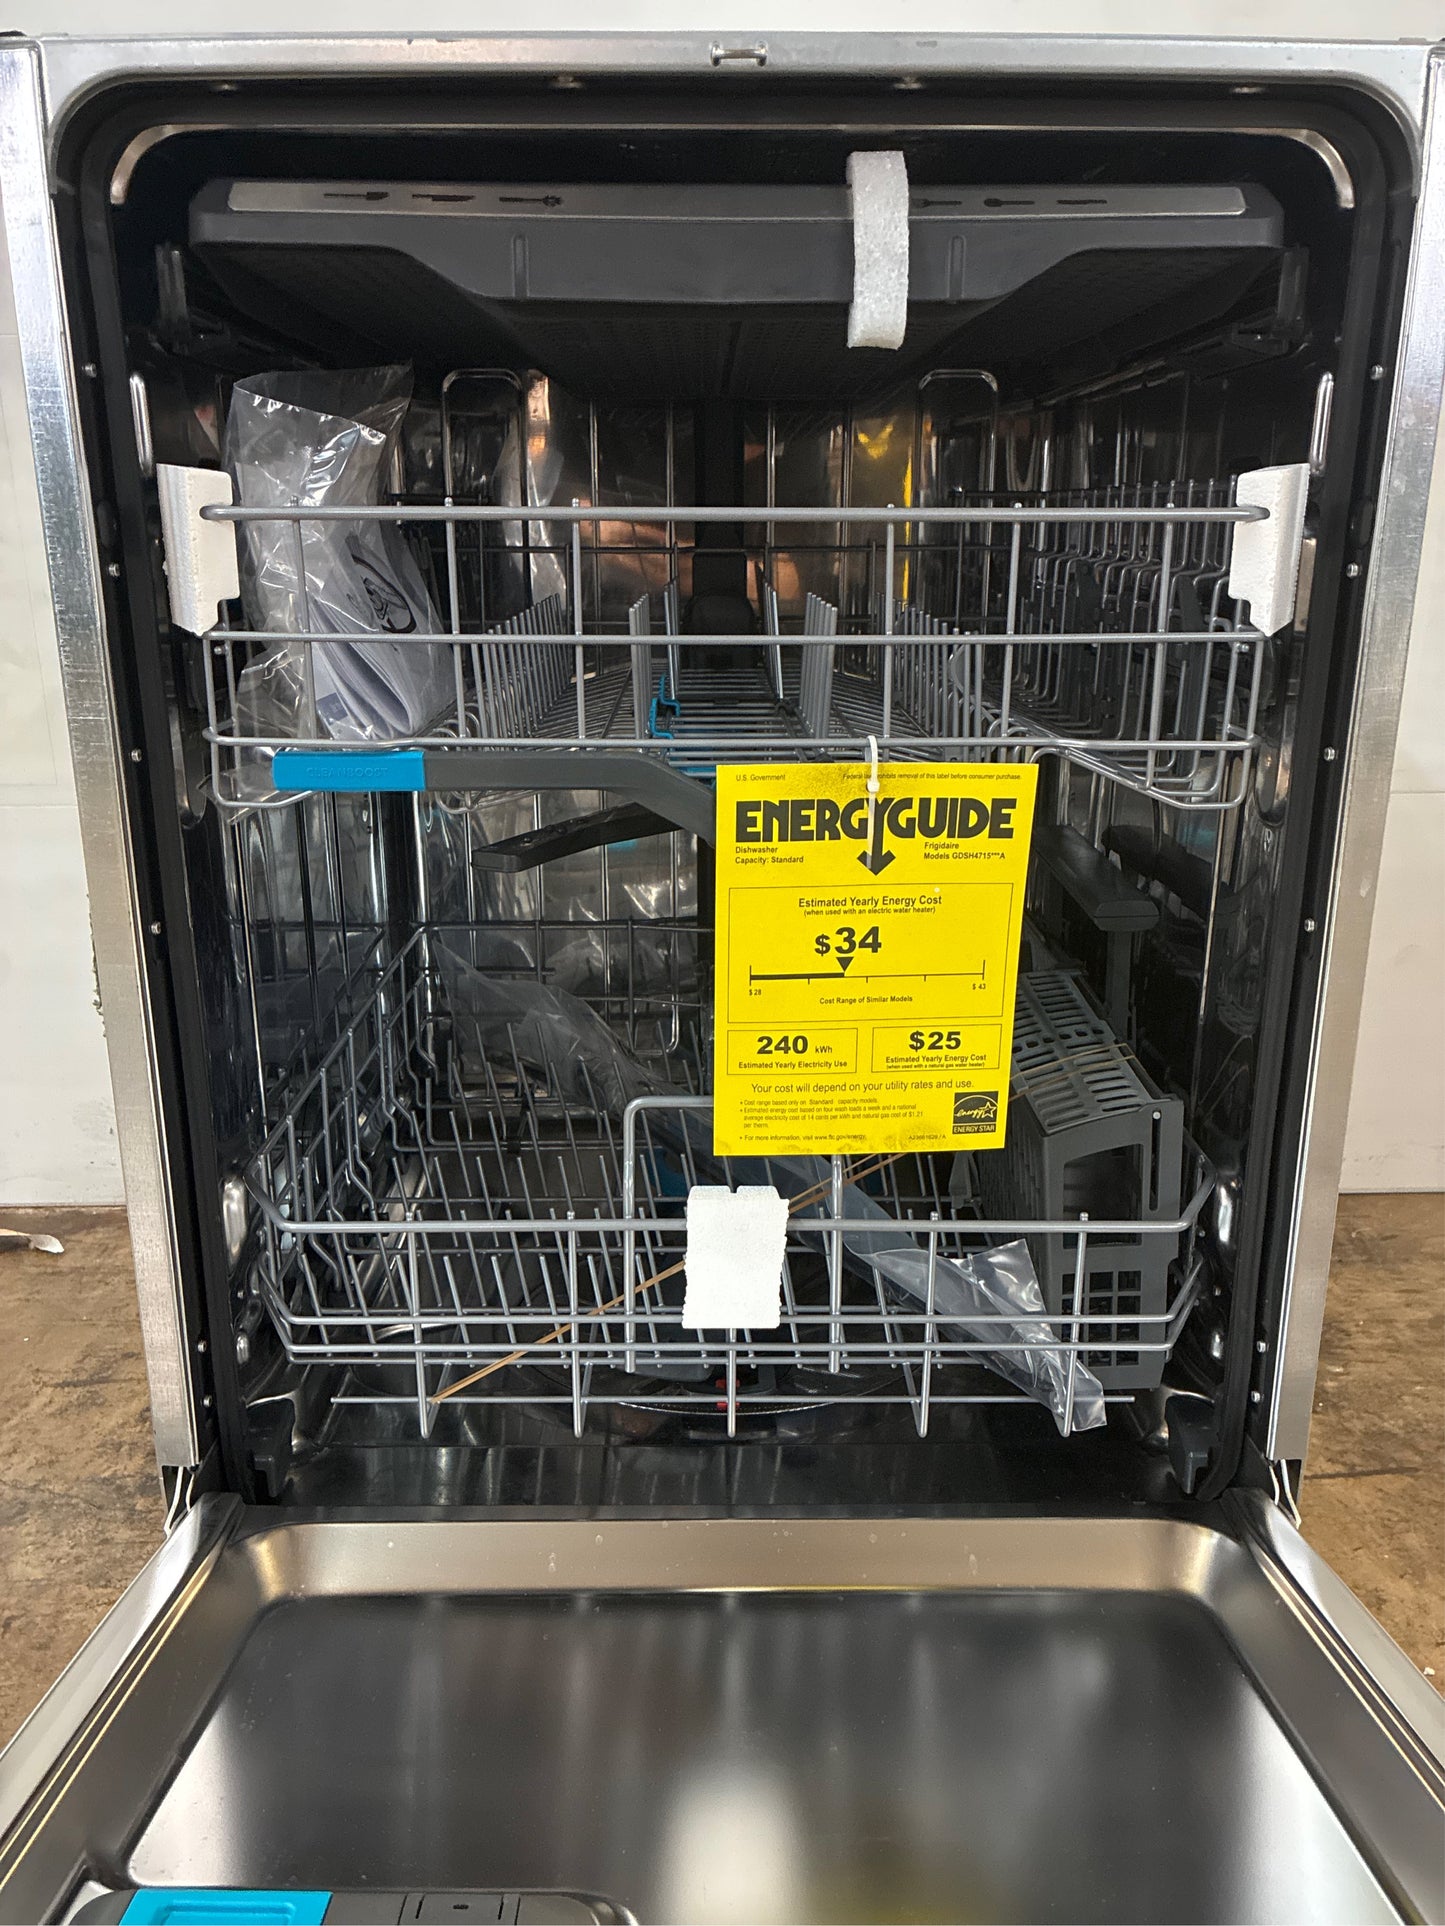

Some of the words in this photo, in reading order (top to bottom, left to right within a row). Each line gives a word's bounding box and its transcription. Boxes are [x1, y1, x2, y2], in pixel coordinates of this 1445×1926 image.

[306, 767, 388, 778] CLEANBOOST
[996, 773, 1021, 781] purchase.
[750, 774, 786, 782] Government
[736, 798, 1017, 843] ENERGYGUIDE
[736, 846, 778, 854] Dishwasher
[925, 842, 959, 851] Frigidaire
[735, 856, 769, 865] Capacity:
[771, 855, 804, 863] Standard
[924, 852, 950, 860] Models
[799, 897, 847, 908] Estimated
[850, 897, 879, 907] Yearly
[882, 896, 916, 907] Energy
[919, 895, 942, 905] Cost
[804, 909, 823, 917] (when
[913, 906, 936, 914] heater)
[814, 926, 882, 956] $34
[836, 997, 856, 1005] Range
[756, 1035, 809, 1054] 240
[909, 1030, 961, 1053] $25
[922, 1055, 943, 1063] Yearly
[945, 1055, 969, 1063] Energy
[739, 1061, 773, 1069] Estimated
[775, 1061, 796, 1070] Yearly
[798, 1060, 832, 1069] Electricity
[751, 1083, 772, 1093] Your
[774, 1084, 793, 1093] cost
[796, 1083, 810, 1092] will
[812, 1082, 846, 1093] depend
[863, 1083, 883, 1093] your
[885, 1081, 908, 1091] utility
[911, 1081, 933, 1089] rates
[935, 1080, 952, 1088] and
